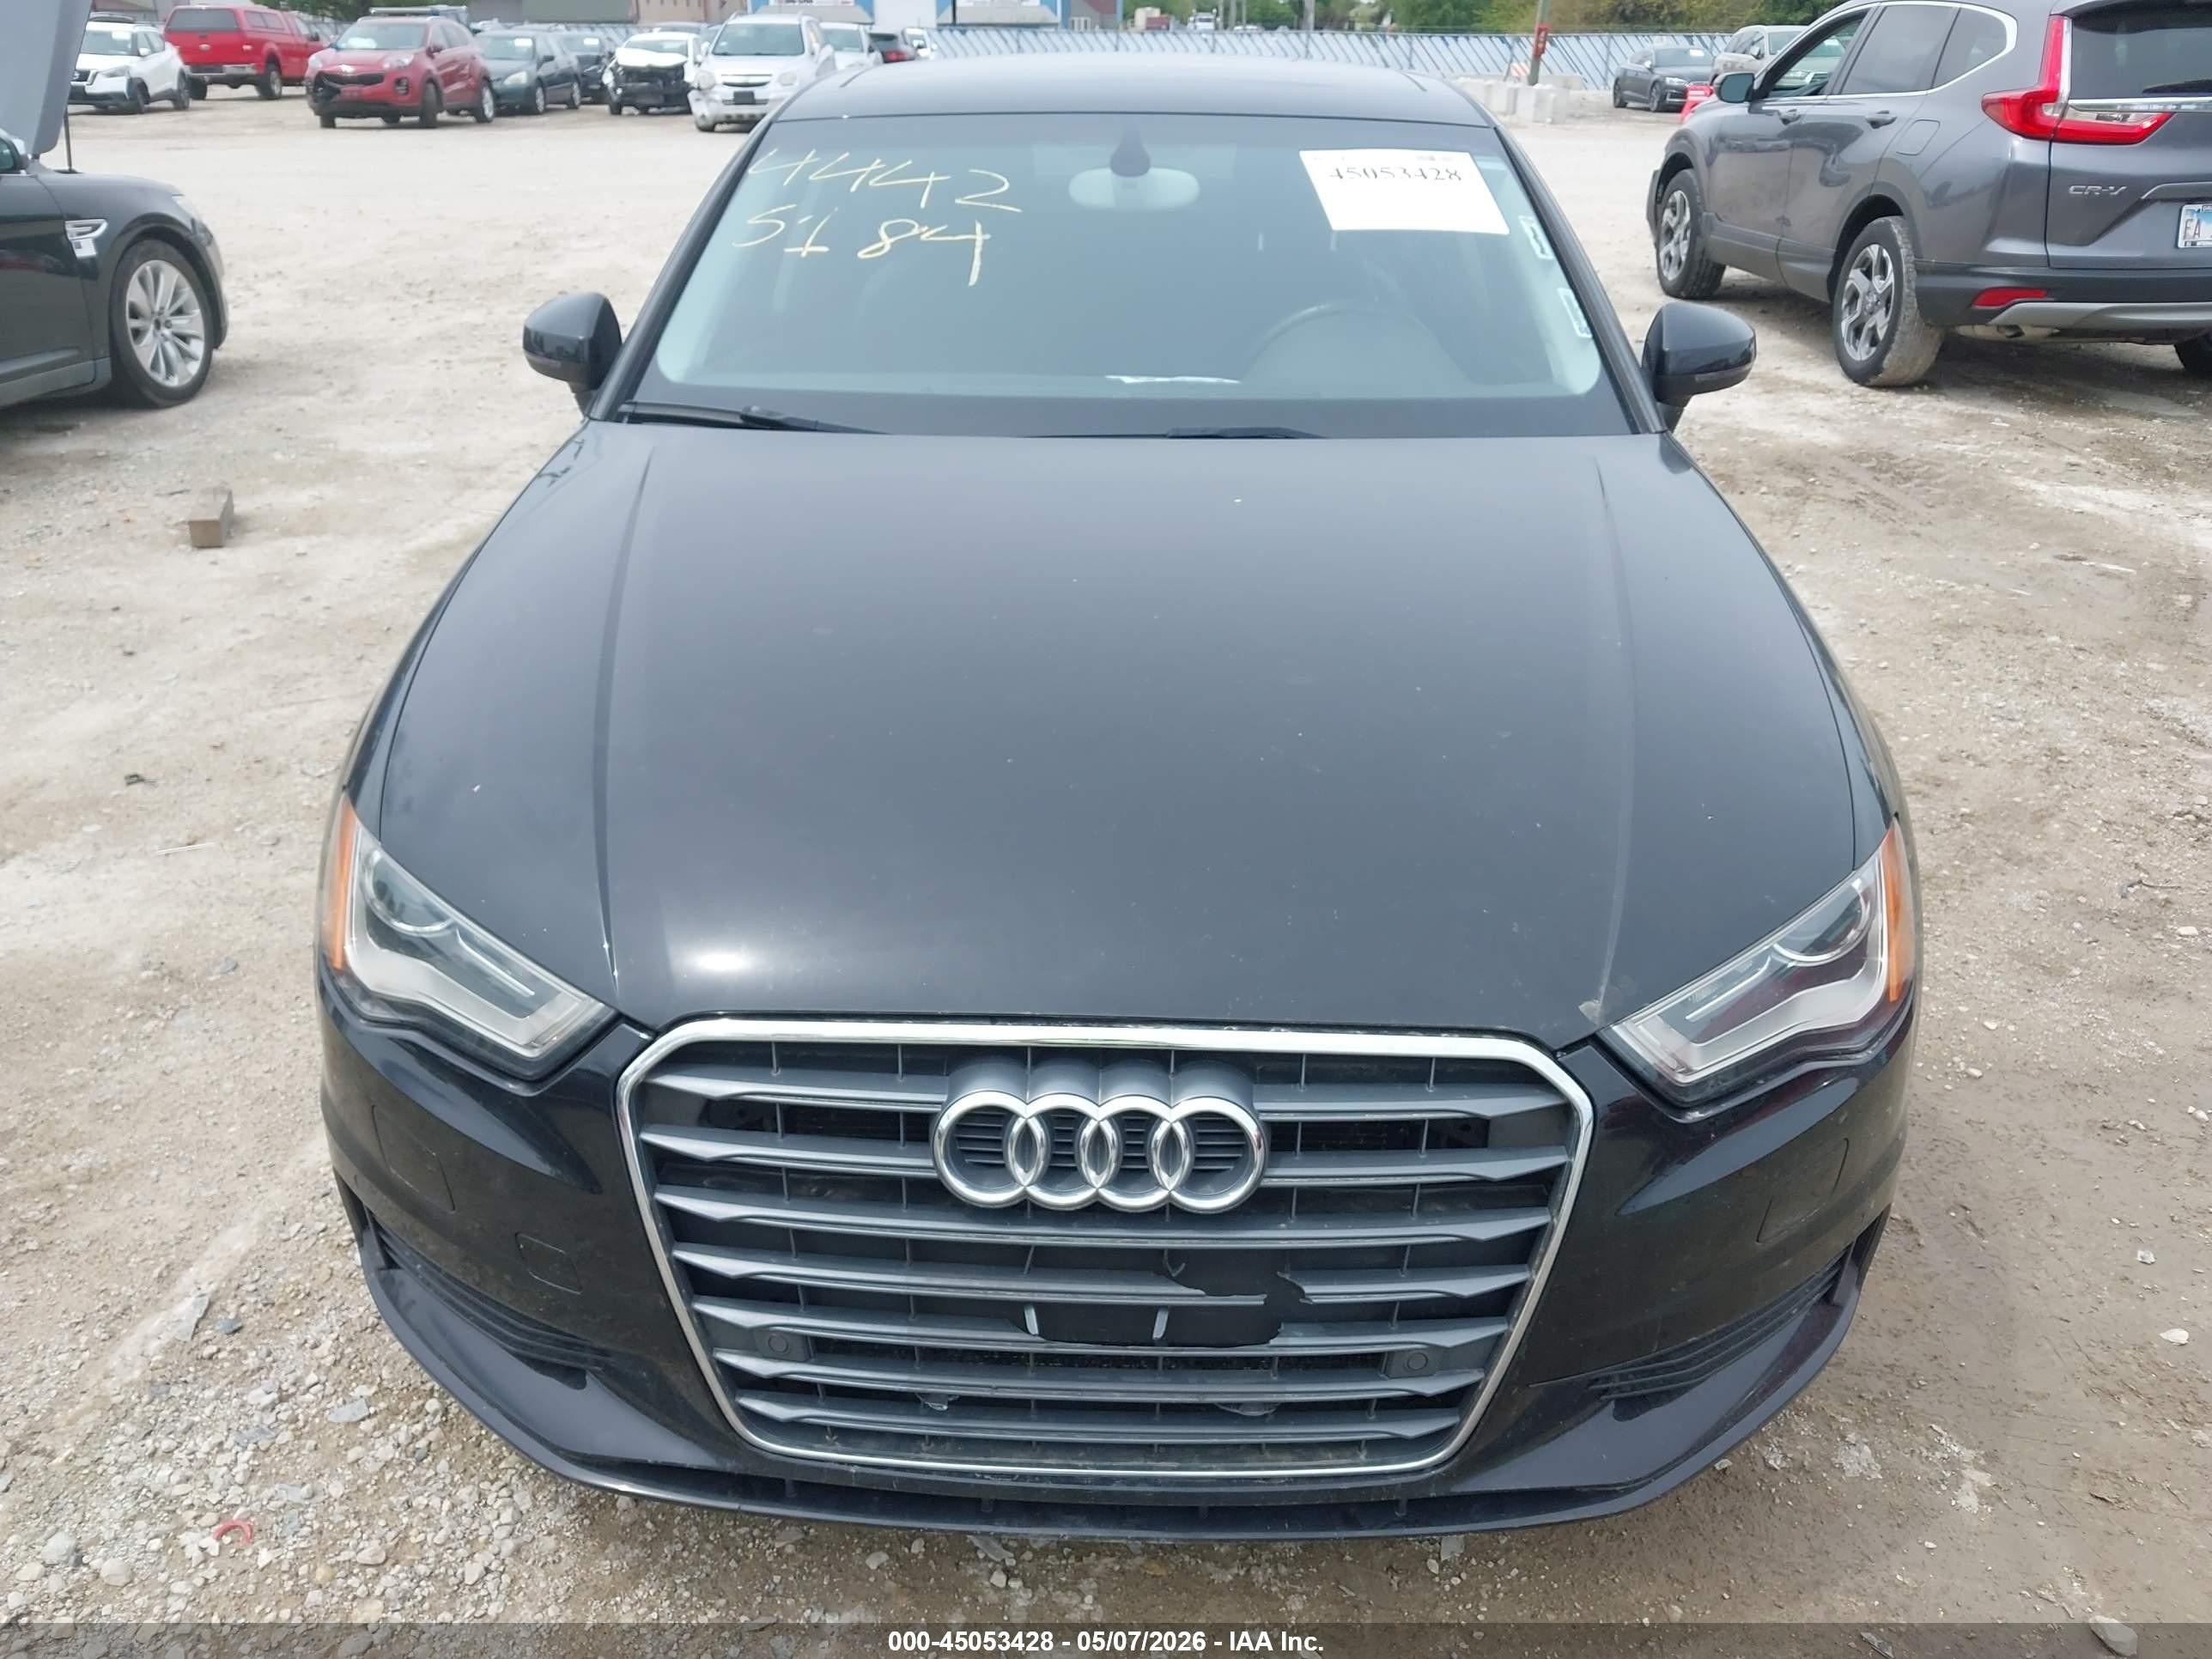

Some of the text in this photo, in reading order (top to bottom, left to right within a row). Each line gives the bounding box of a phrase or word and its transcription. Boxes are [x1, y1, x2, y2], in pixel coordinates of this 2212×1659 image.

[748, 149, 1023, 213] 4442
[1330, 167, 1462, 181] 45053428
[2069, 185, 2127, 195] CR-V
